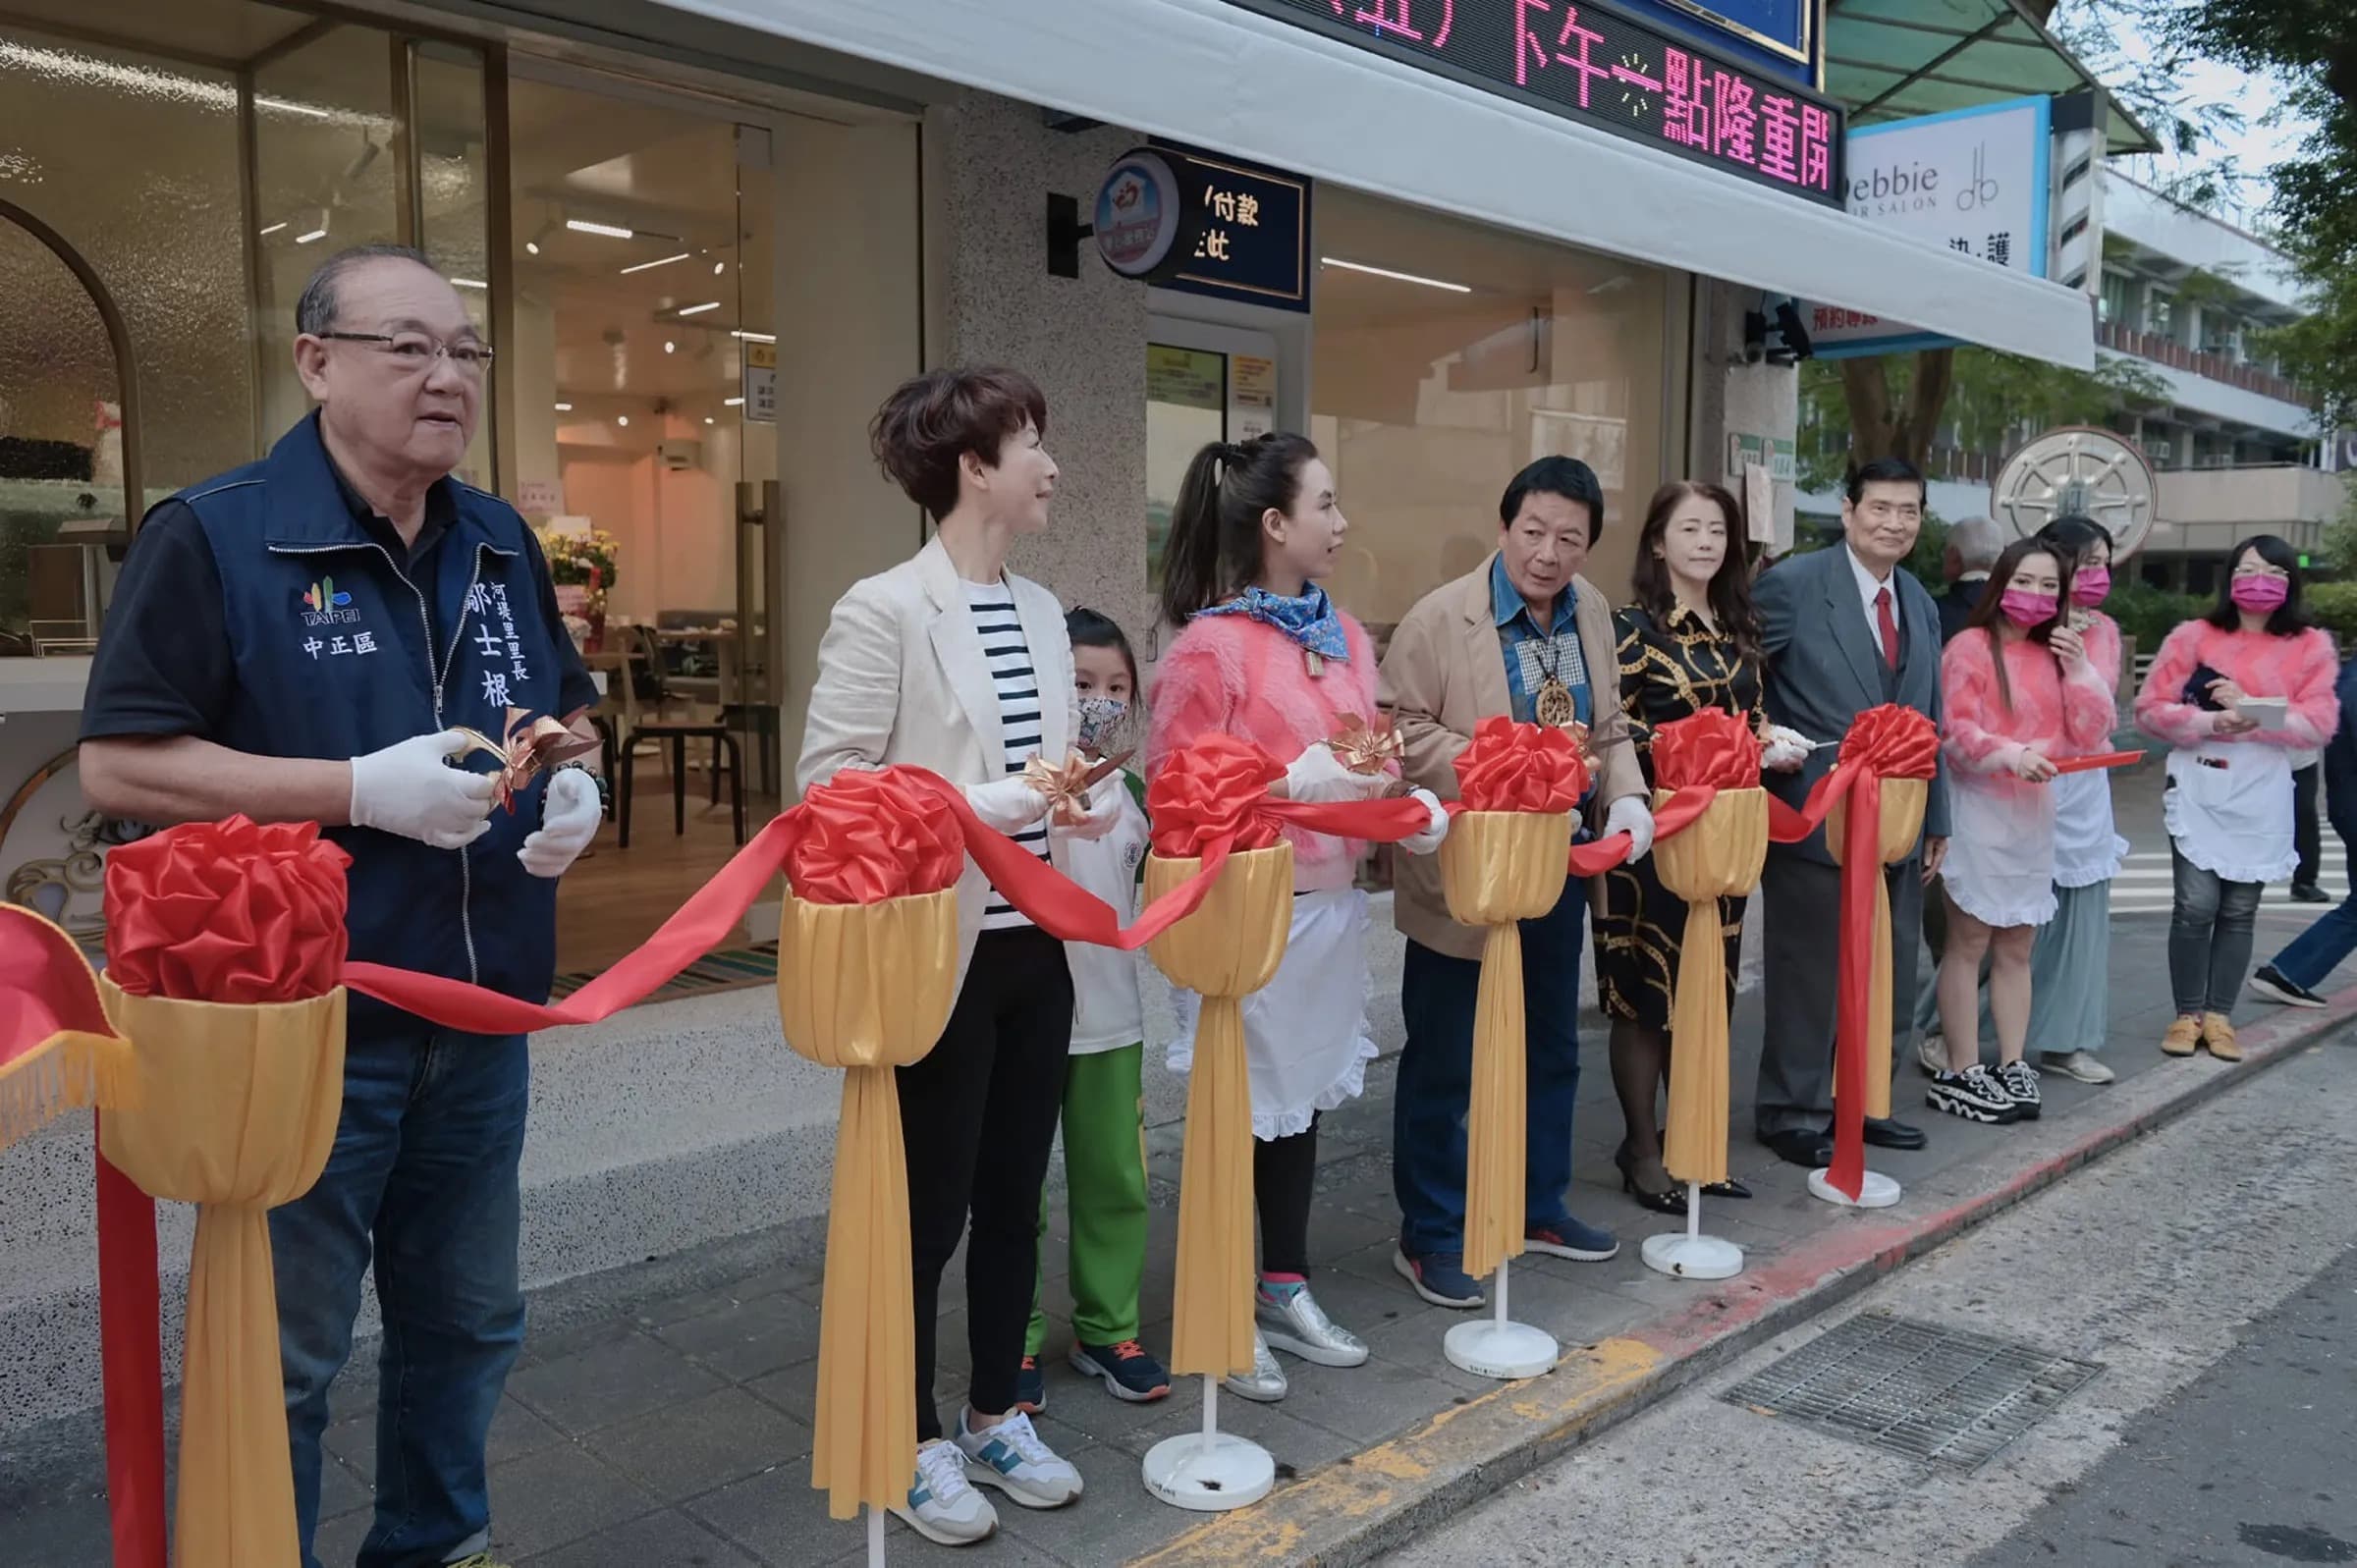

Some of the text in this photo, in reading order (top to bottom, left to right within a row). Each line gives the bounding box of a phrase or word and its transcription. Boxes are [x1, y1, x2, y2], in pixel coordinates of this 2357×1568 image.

[1846, 161, 1939, 201] ebbie
[1204, 184, 1258, 226] 付款
[1877, 196, 1937, 216] SALON
[301, 609, 360, 626] TAIPEI
[302, 631, 377, 660] 中正區
